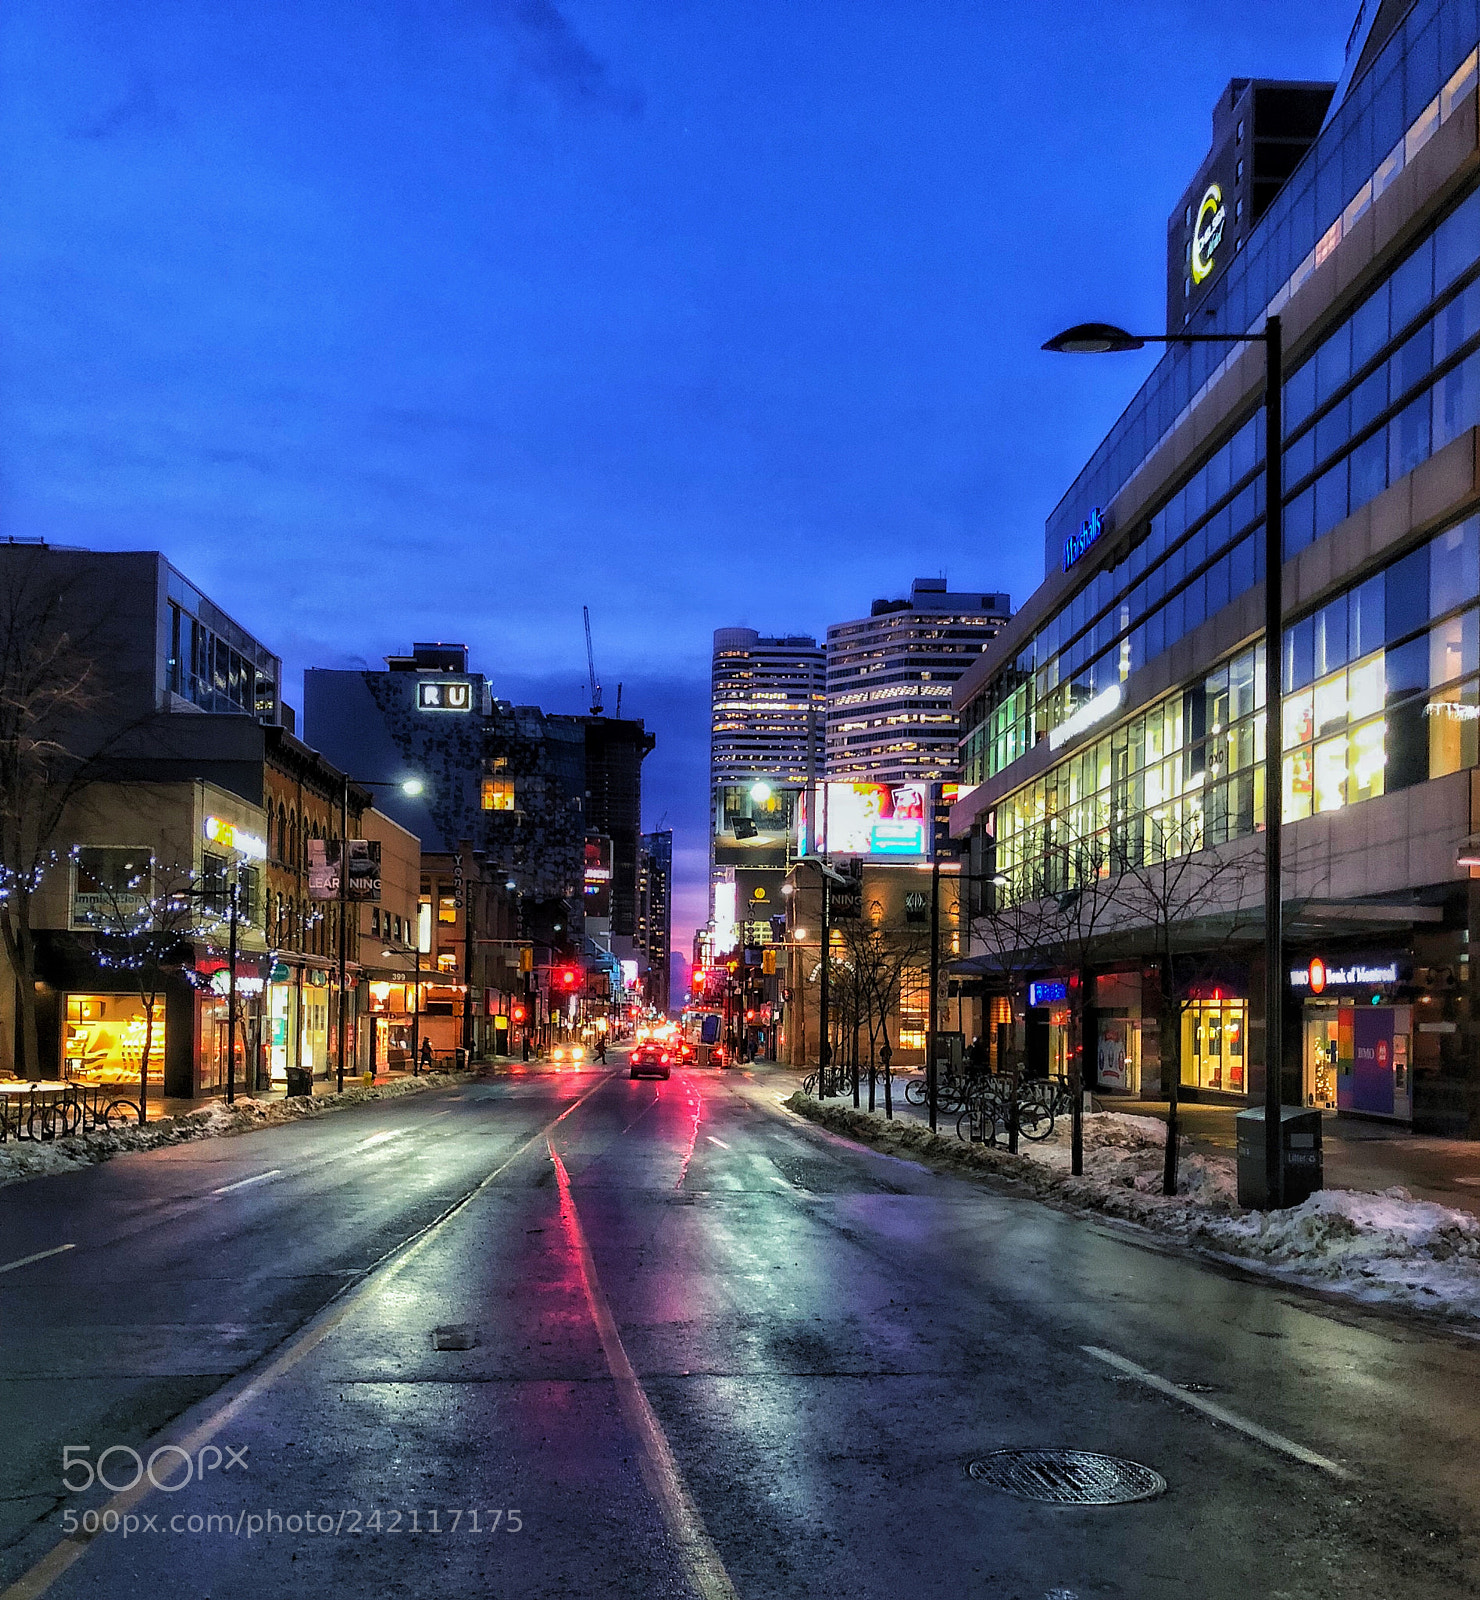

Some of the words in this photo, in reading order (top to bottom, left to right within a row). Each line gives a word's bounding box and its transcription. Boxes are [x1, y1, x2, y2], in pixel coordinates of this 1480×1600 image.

[1063, 508, 1101, 573] Marshalls
[308, 877, 340, 890] LEAR
[392, 973, 406, 981] 399
